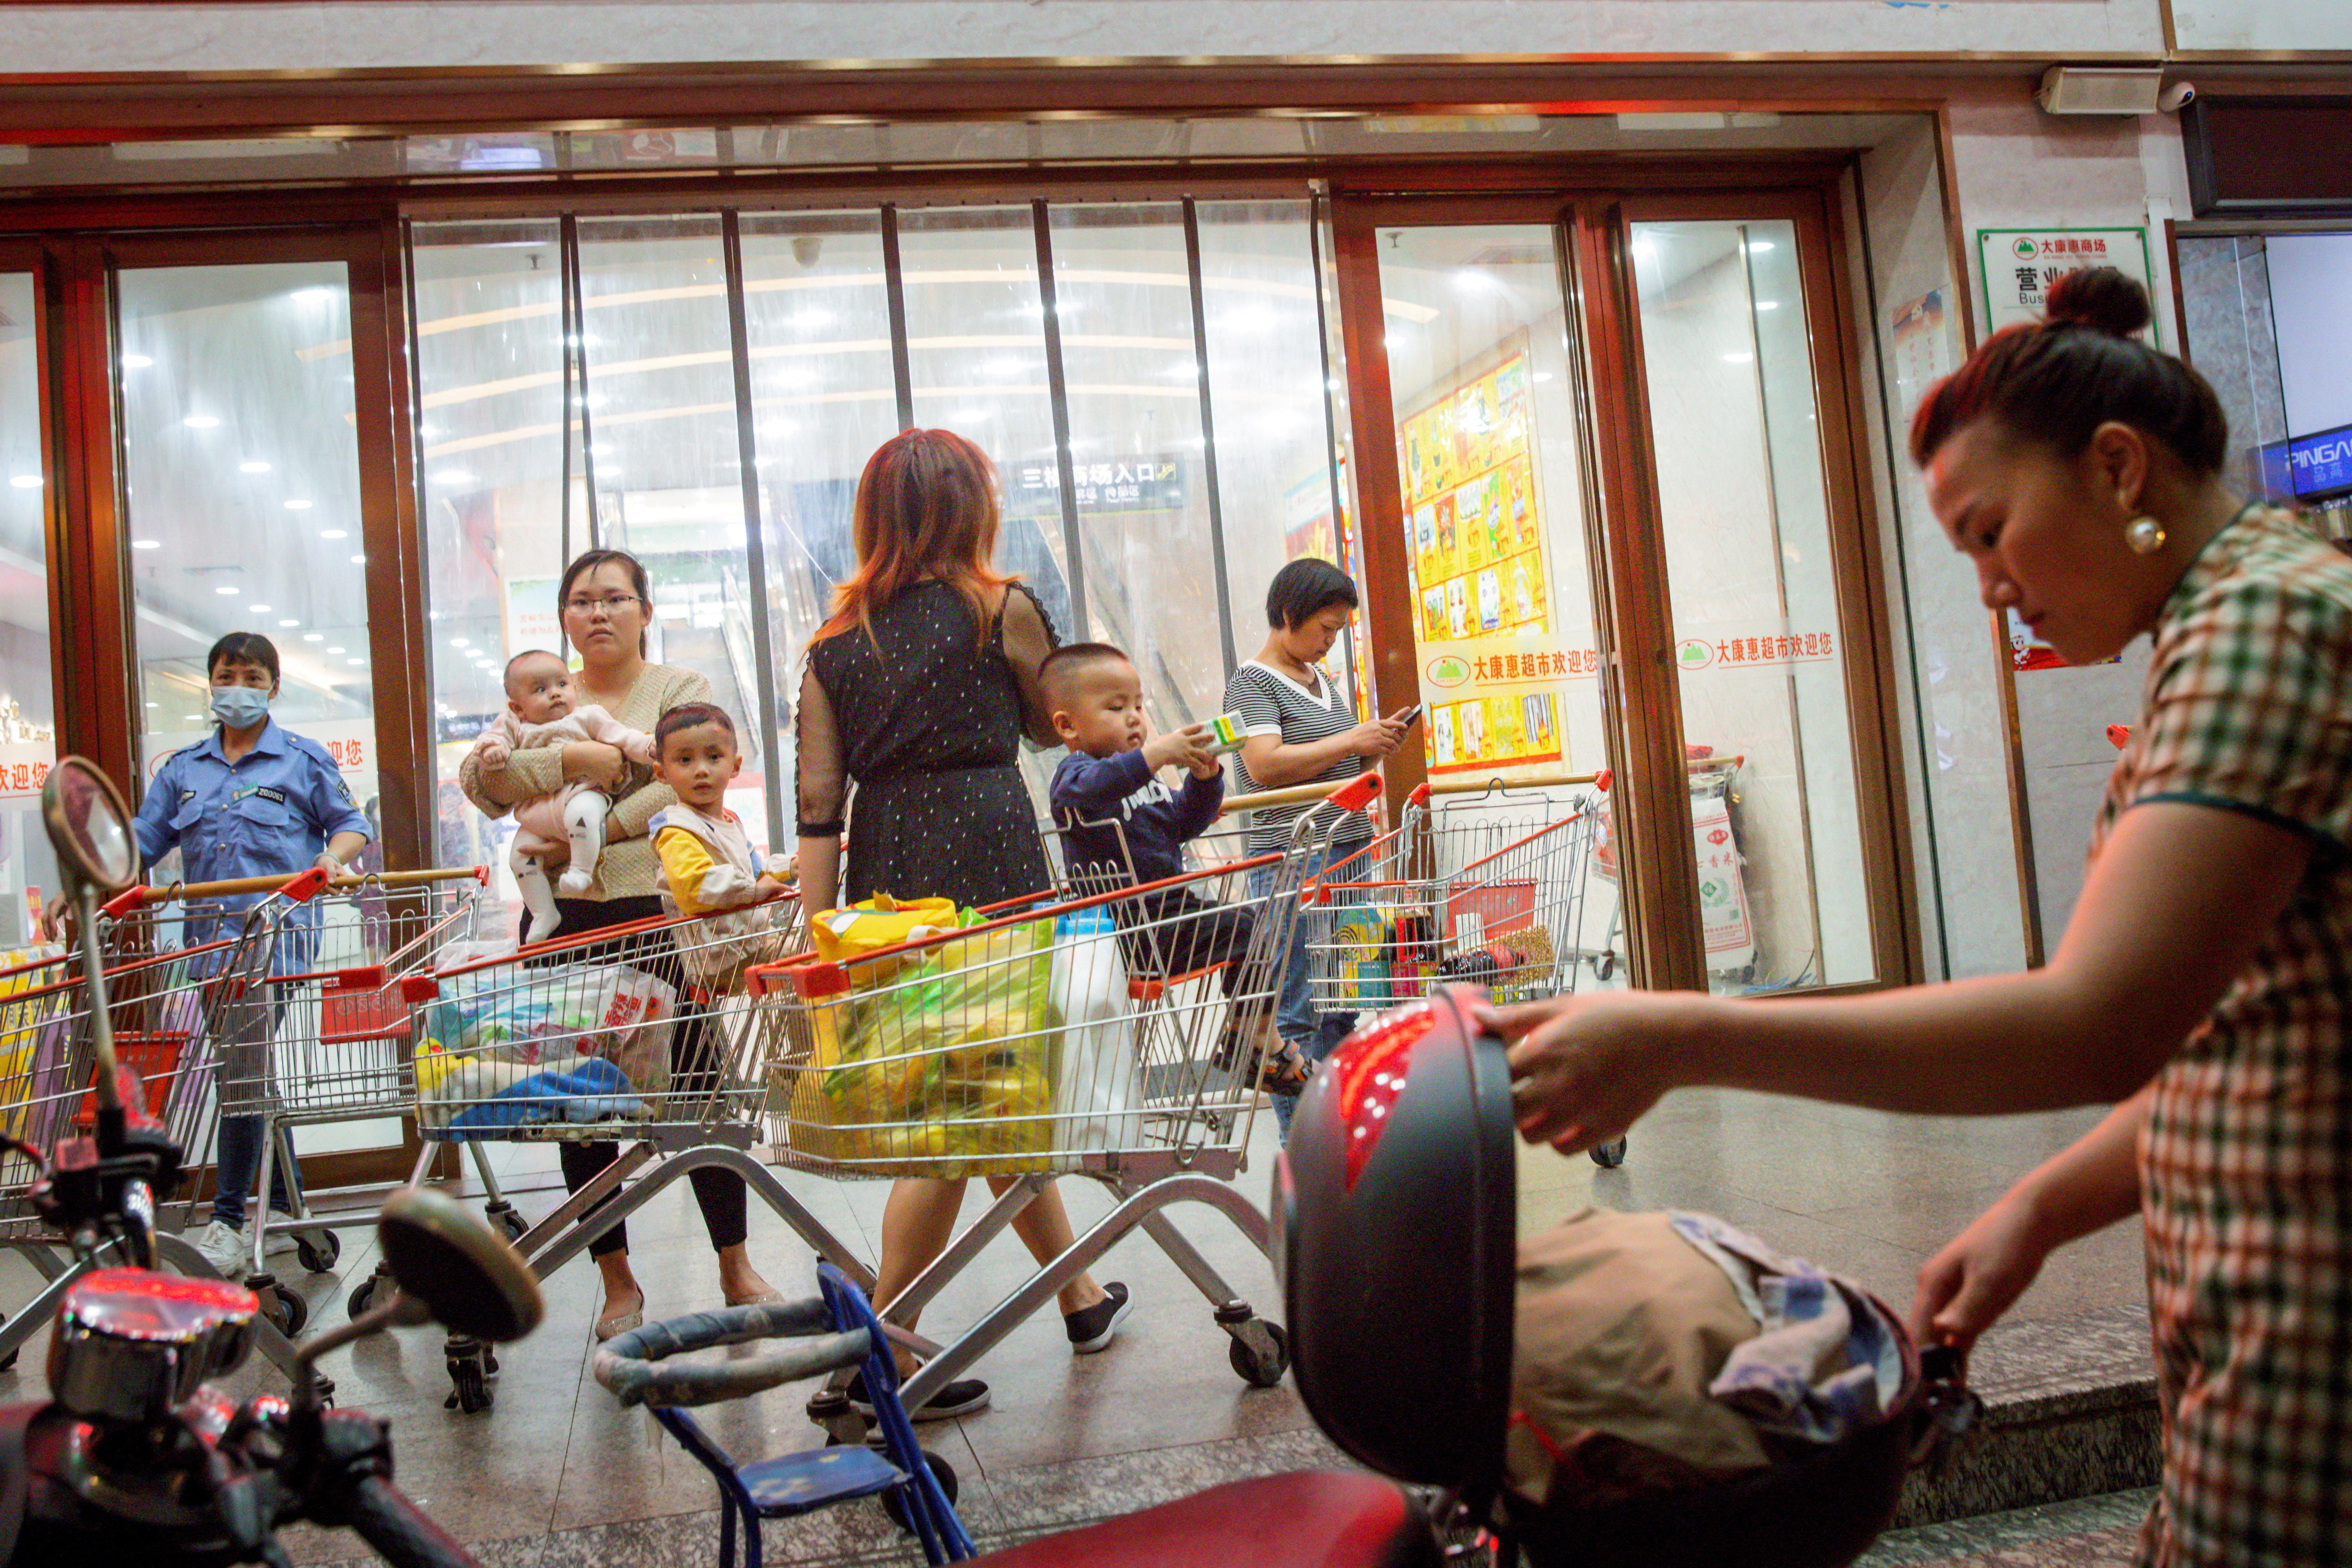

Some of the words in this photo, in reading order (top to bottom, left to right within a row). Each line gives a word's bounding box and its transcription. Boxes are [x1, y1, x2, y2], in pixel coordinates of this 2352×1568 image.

[2041, 239, 2106, 254] 大康惠商场
[2285, 438, 2352, 472] PINGA
[1717, 632, 1833, 663] 大康惠超市欢迎您
[1473, 649, 1598, 681] 大康惠超市欢迎您
